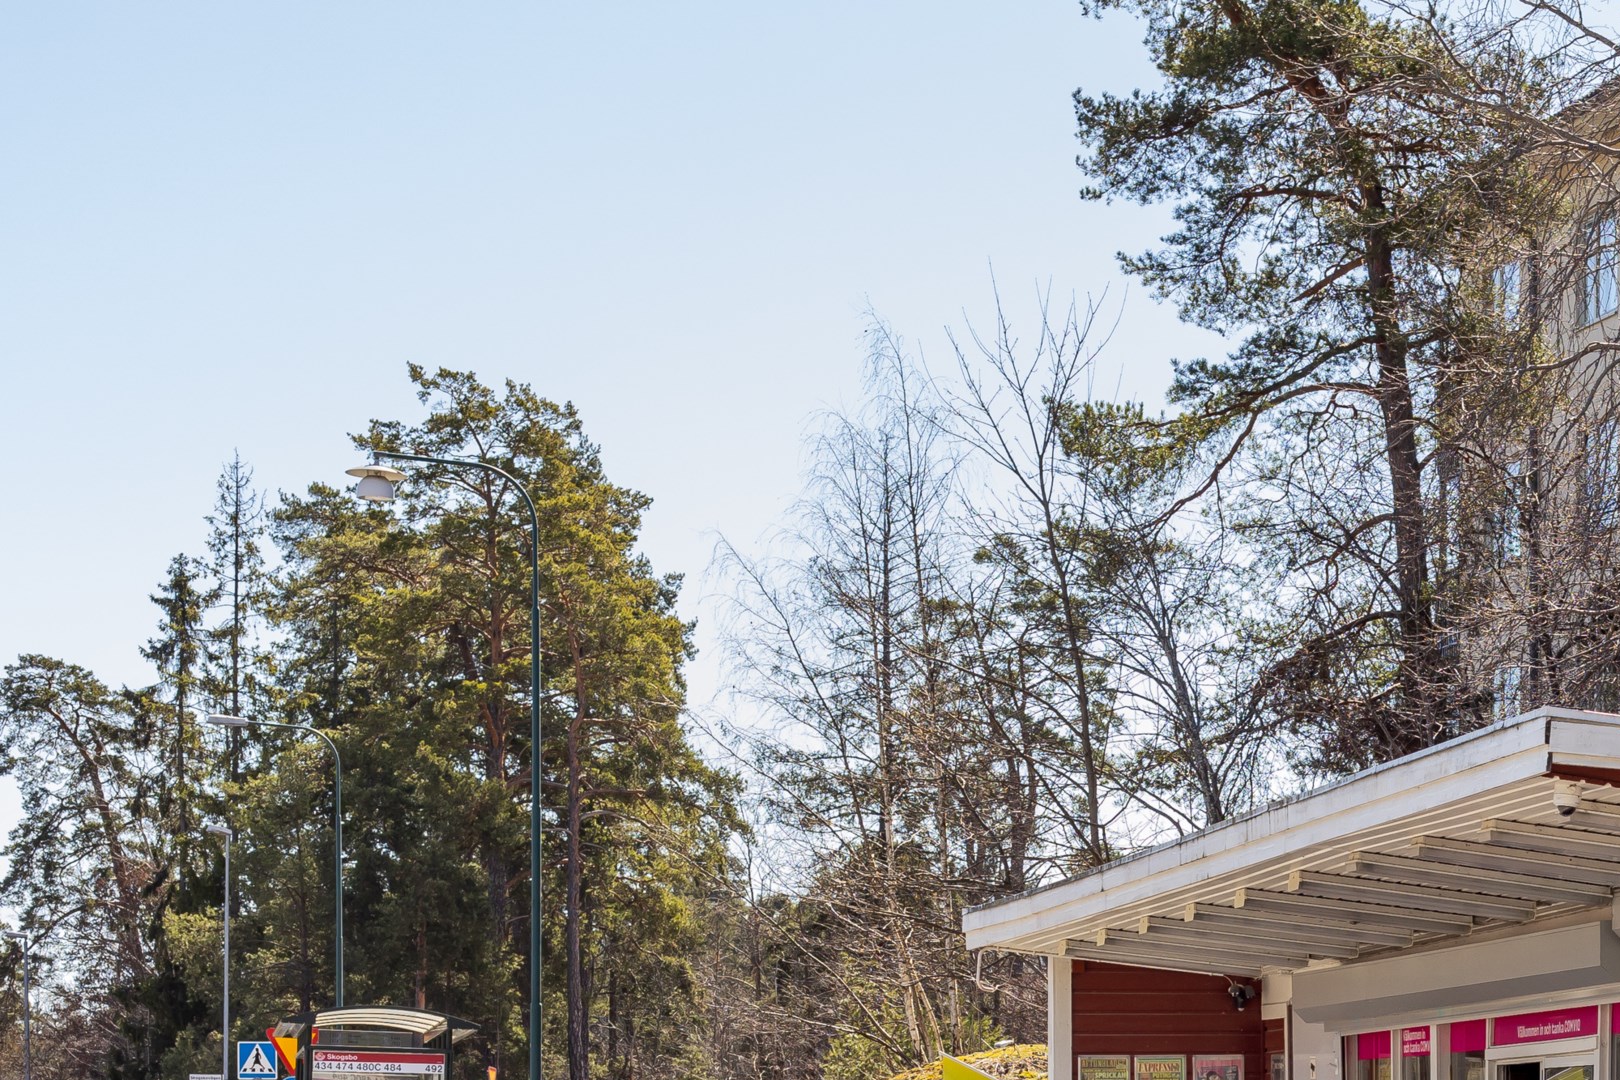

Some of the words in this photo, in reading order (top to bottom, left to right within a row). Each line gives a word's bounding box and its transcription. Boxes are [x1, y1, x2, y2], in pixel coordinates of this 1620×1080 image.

[1517, 1024, 1539, 1038] Välkommen
[1552, 1022, 1564, 1034] tanka
[1564, 1019, 1581, 1033] COMVIQ
[327, 1053, 358, 1061] Skogsbo
[314, 1062, 333, 1070] 434
[335, 1062, 353, 1070] 474
[356, 1063, 382, 1071] 480C
[425, 1065, 443, 1073] 492
